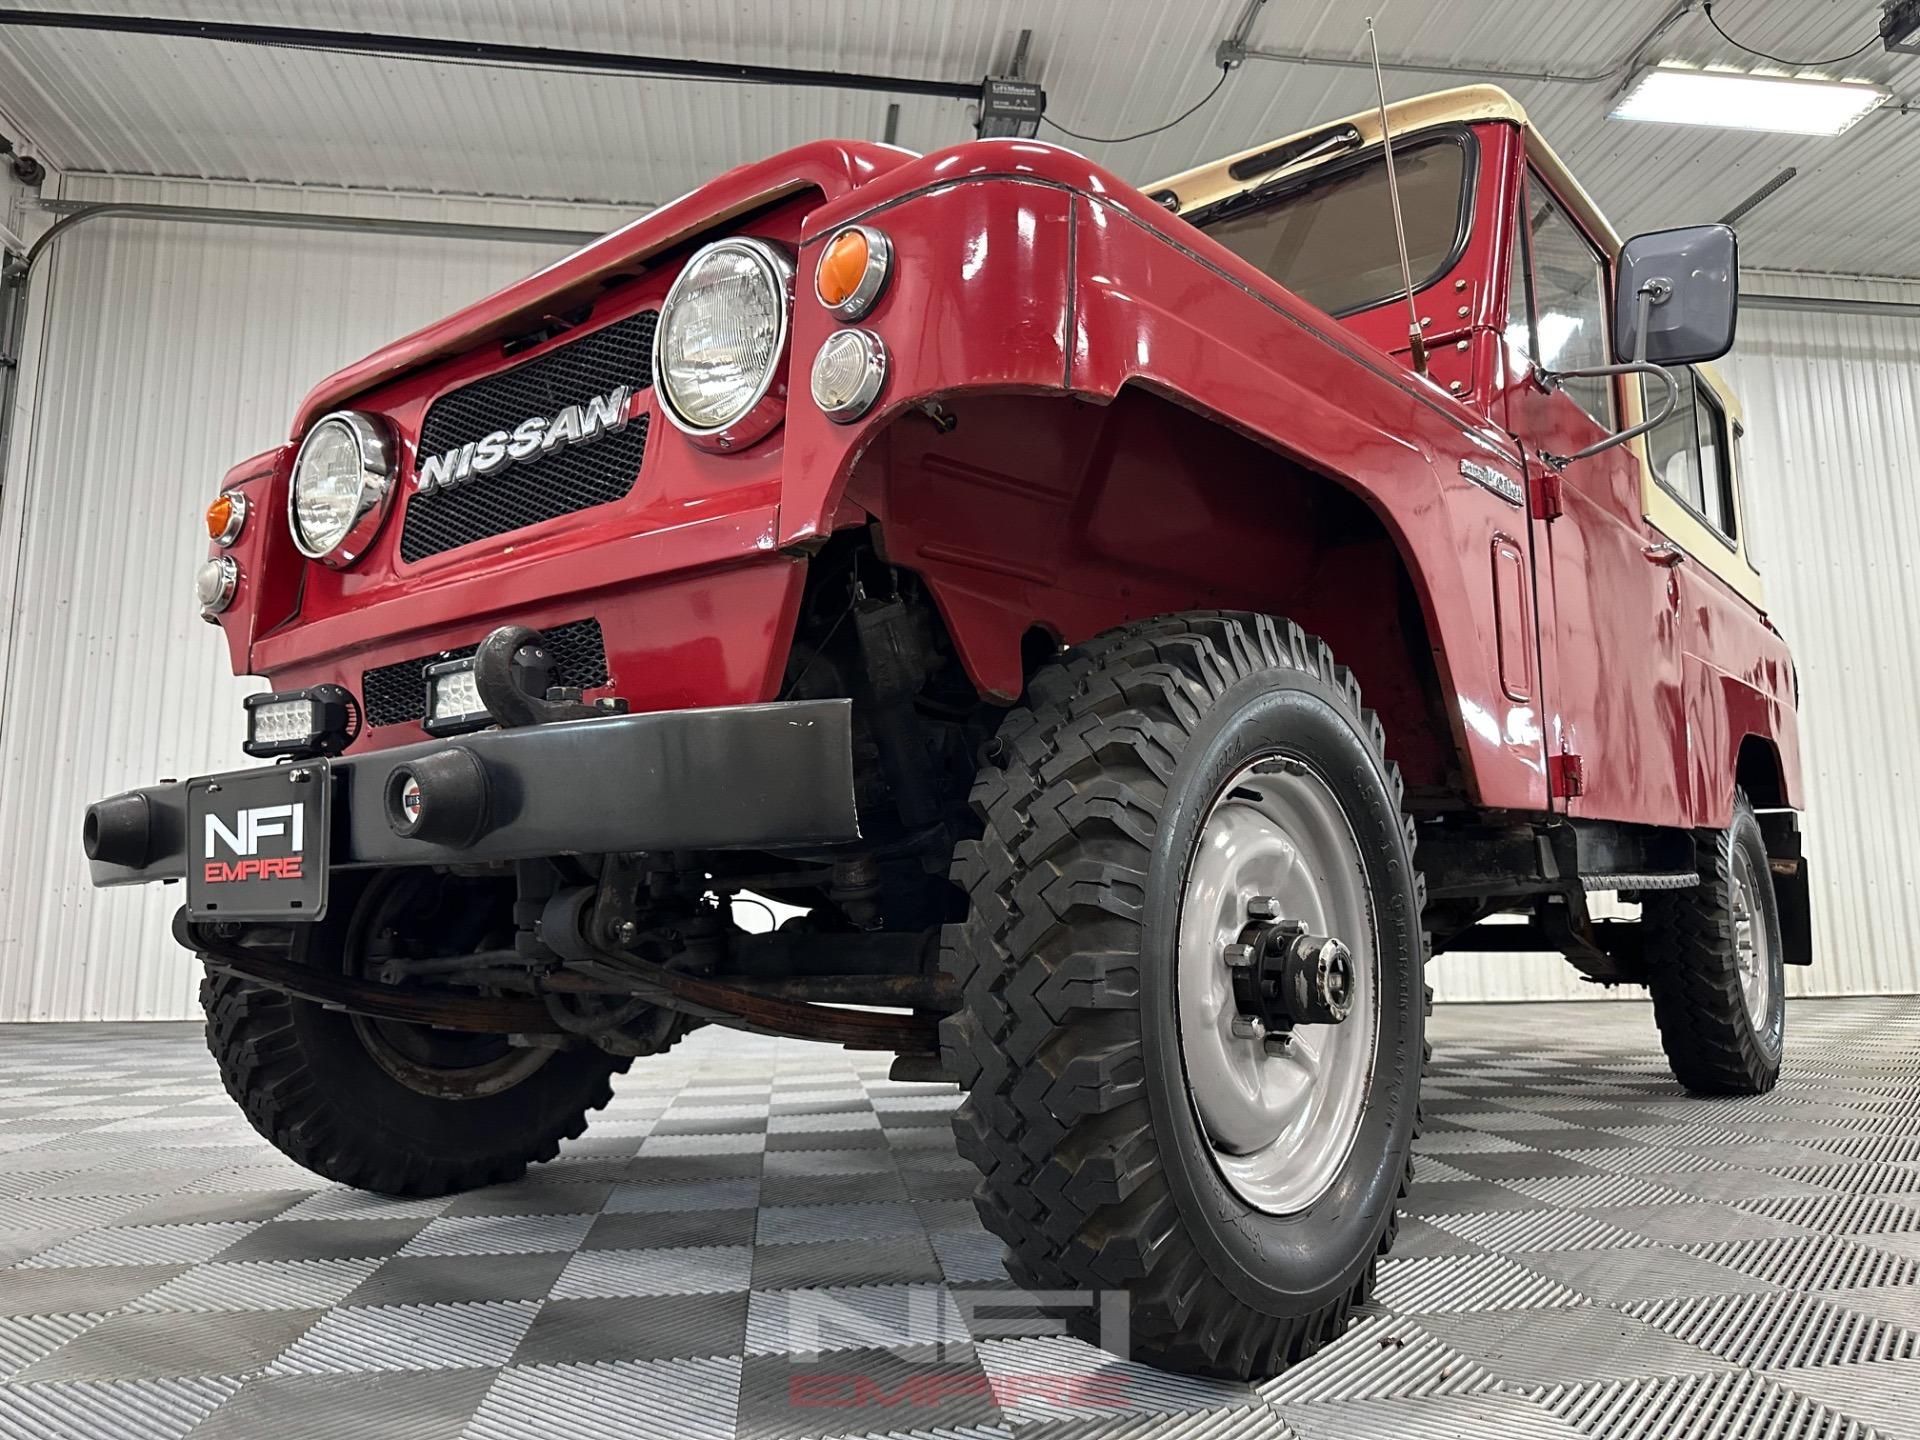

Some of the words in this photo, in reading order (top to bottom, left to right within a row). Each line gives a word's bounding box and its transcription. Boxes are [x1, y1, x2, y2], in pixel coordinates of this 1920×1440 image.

[418, 385, 632, 495] NISSAN
[204, 802, 304, 859] NFI
[204, 856, 303, 883] EMPIRE
